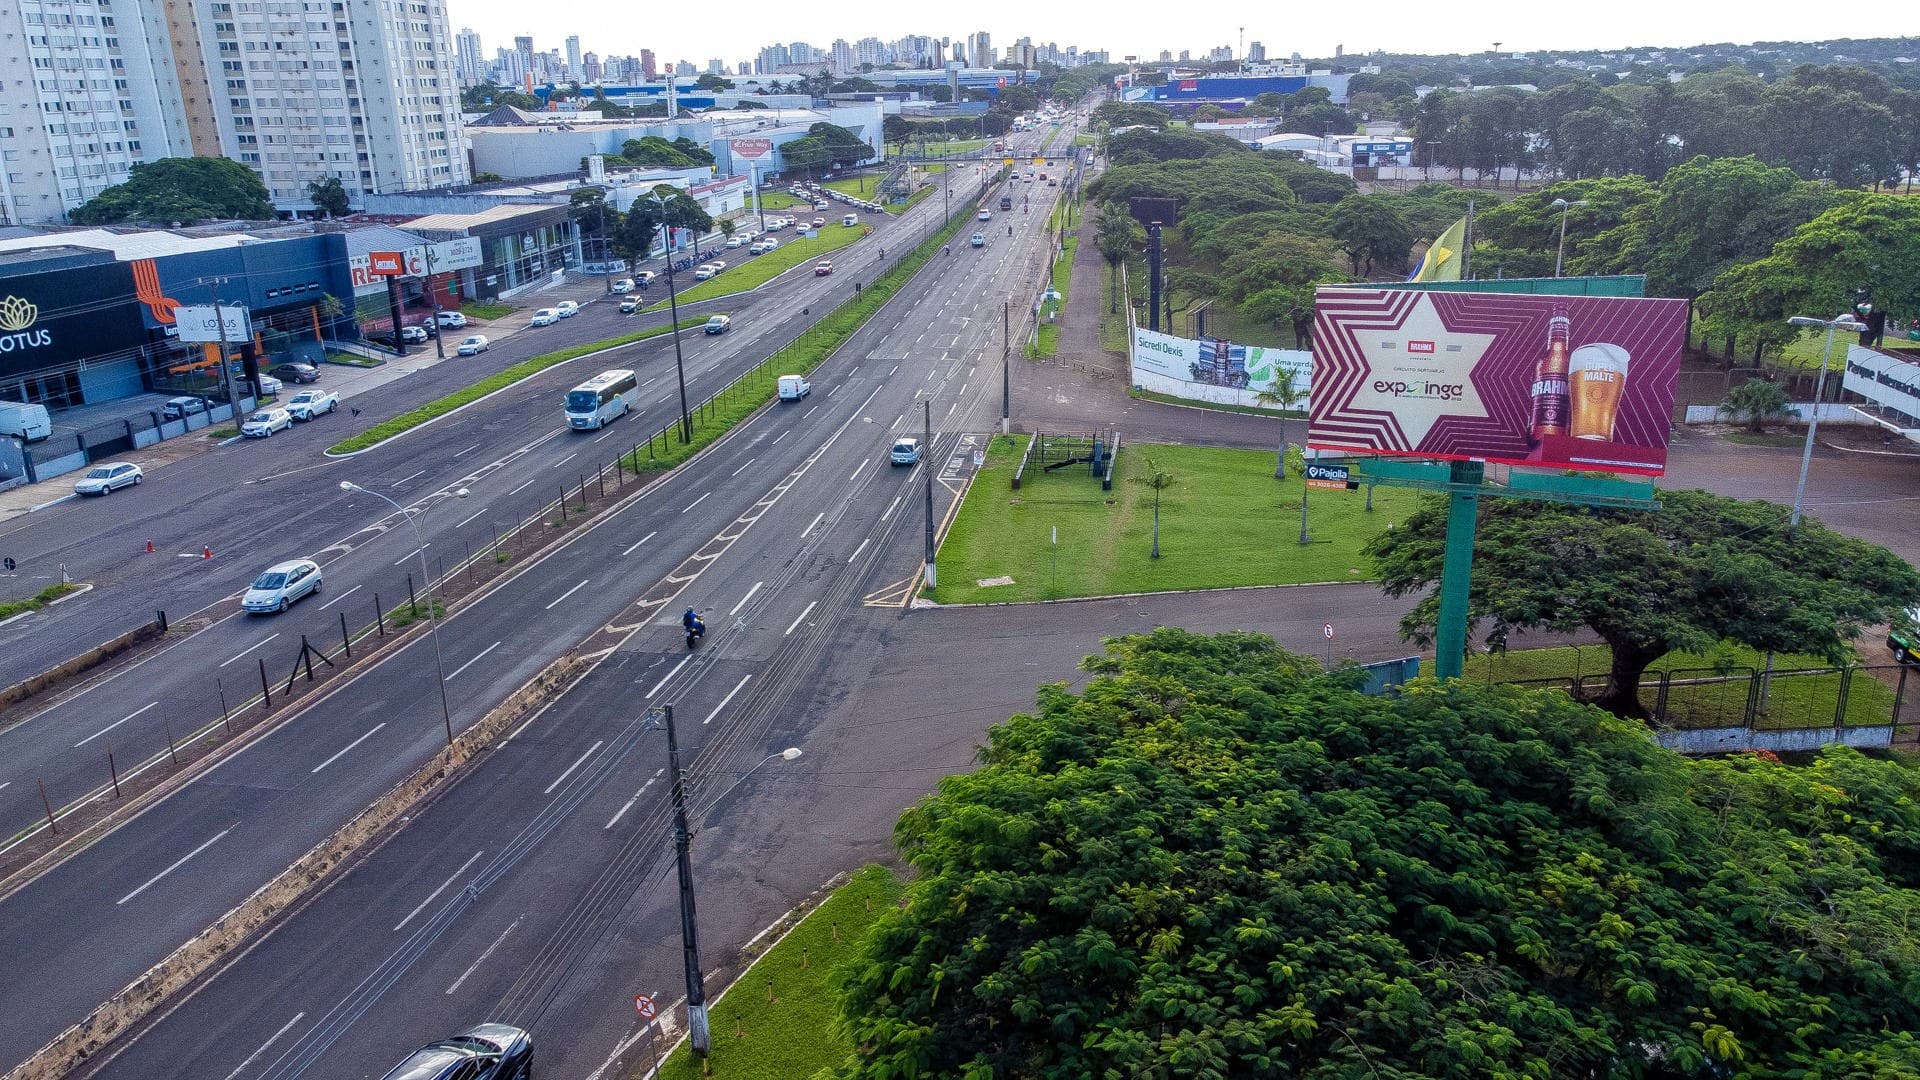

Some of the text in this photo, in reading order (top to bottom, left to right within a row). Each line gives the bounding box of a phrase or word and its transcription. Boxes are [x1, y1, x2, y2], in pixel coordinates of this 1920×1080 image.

[0, 329, 52, 354] OTUS
[1139, 337, 1183, 357] Sicredi Dexis
[1583, 371, 1615, 383] MALTE
[1319, 468, 1347, 479] Pajolla
